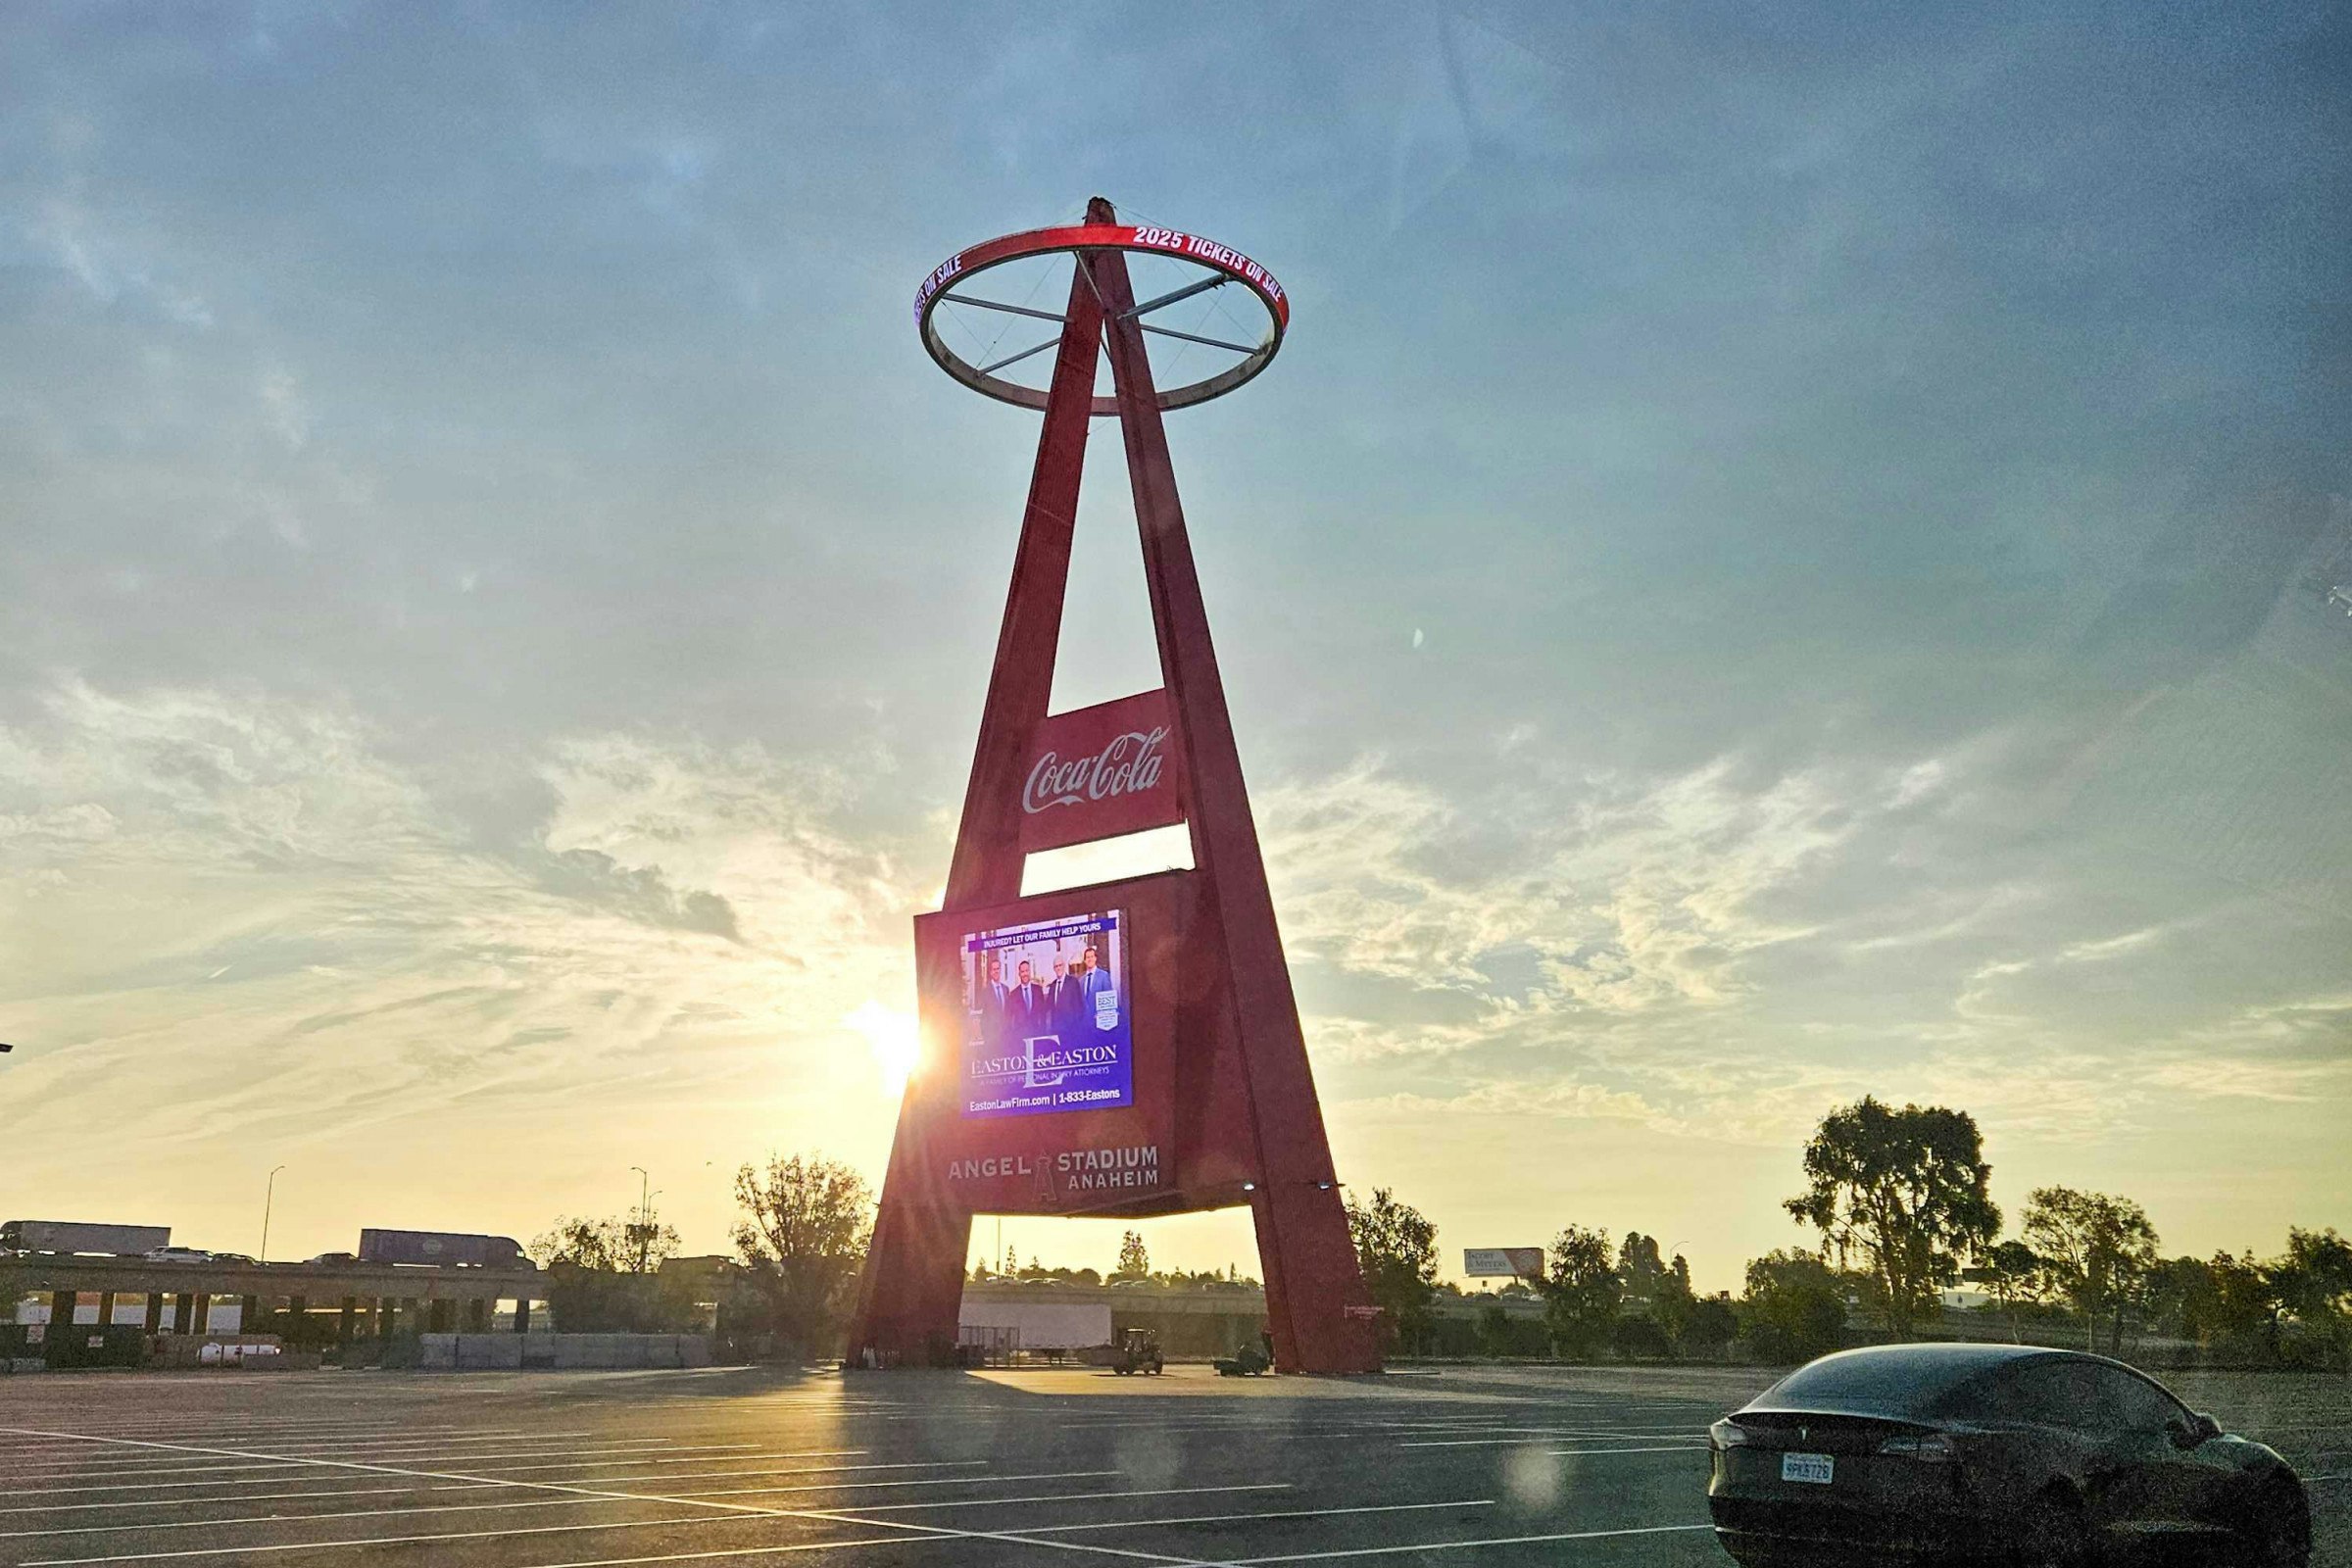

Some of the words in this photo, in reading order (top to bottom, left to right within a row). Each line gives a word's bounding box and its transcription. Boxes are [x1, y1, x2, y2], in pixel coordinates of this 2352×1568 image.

[924, 274, 937, 296] ON
[937, 255, 962, 284] SALE
[1133, 226, 1184, 248] 2025
[1187, 235, 1246, 270] TICKETS
[1246, 260, 1264, 282] ON
[1262, 273, 1283, 303] SALE
[1022, 725, 1171, 813] Coca-Cola
[984, 936, 1012, 949] INJURED?
[1012, 935, 1025, 944] LET
[1024, 932, 1039, 942] OUR
[1039, 929, 1061, 940] FAMILY
[1061, 926, 1078, 936] HELP
[1078, 922, 1102, 934] YOURS
[1051, 1044, 1117, 1066] EASTON
[970, 1095, 1051, 1111] EastonLawFirm.com
[1059, 1088, 1120, 1103] 1-833-Eastons
[949, 1155, 1032, 1180] ANGEL
[1057, 1146, 1158, 1172] STADIUM
[1068, 1170, 1158, 1190] ANAHEIM
